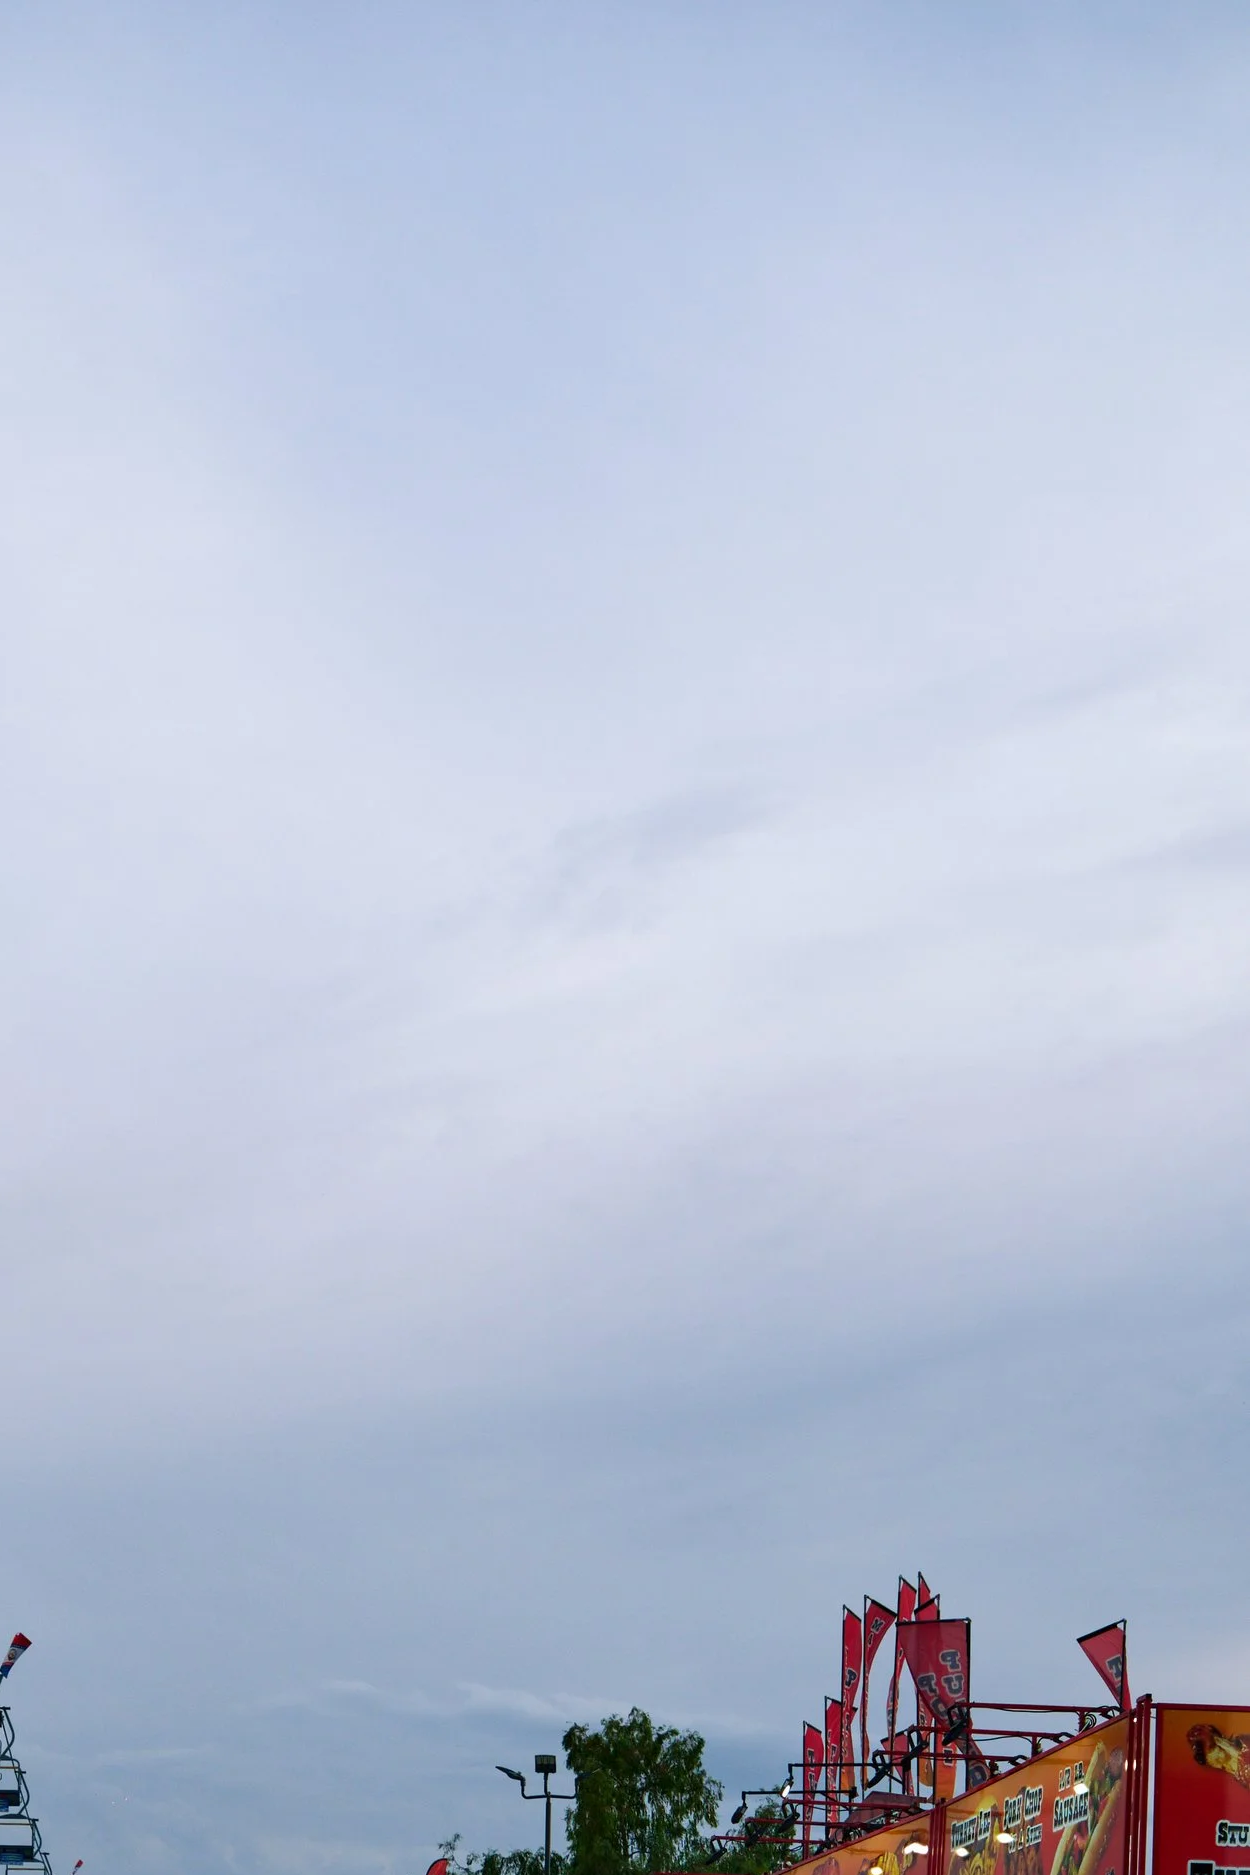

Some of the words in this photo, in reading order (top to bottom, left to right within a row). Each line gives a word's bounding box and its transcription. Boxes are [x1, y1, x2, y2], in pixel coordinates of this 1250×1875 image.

[1003, 1794, 1023, 1832] PORK
[1024, 1783, 1044, 1822] CHOP
[1052, 1790, 1090, 1833] SAUSAGE
[951, 1814, 978, 1853] TURKEY
